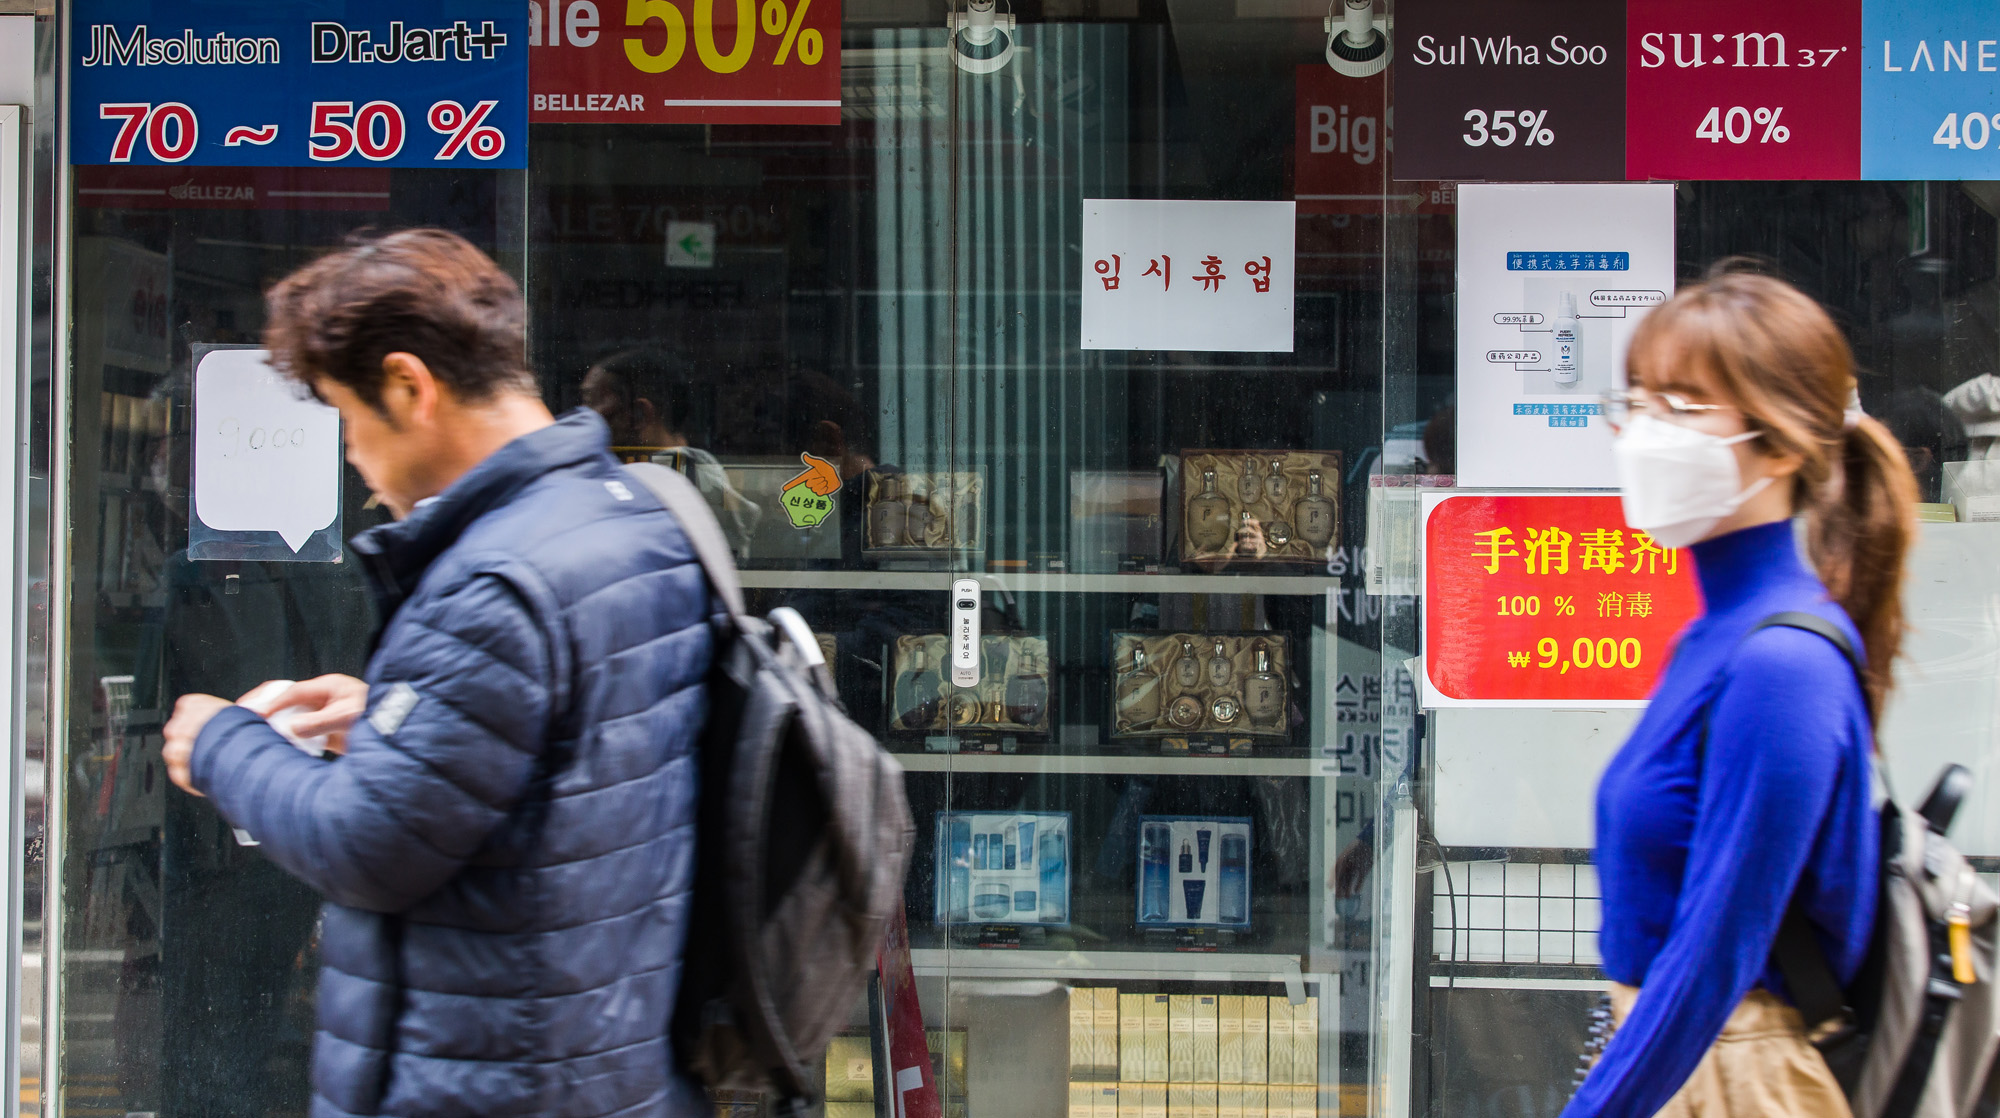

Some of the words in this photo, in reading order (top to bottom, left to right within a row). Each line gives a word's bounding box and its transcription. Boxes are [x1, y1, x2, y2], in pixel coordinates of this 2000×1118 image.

[82, 24, 280, 67] JMsolution
[311, 20, 508, 64] Dr.Jart+
[623, 0, 824, 75] 50%
[533, 94, 645, 112] BELLEZAR
[99, 101, 200, 163] 70
[308, 99, 406, 162] 50
[426, 99, 507, 161] %
[1310, 105, 1376, 165] Big
[1463, 108, 1555, 148] 35%
[1695, 106, 1791, 144] 40%
[789, 495, 828, 511] 신상품
[1470, 526, 1679, 576] 手消毒剂
[1497, 596, 1541, 616] 100
[1554, 596, 1575, 616] %
[1597, 591, 1653, 618] 消毒
